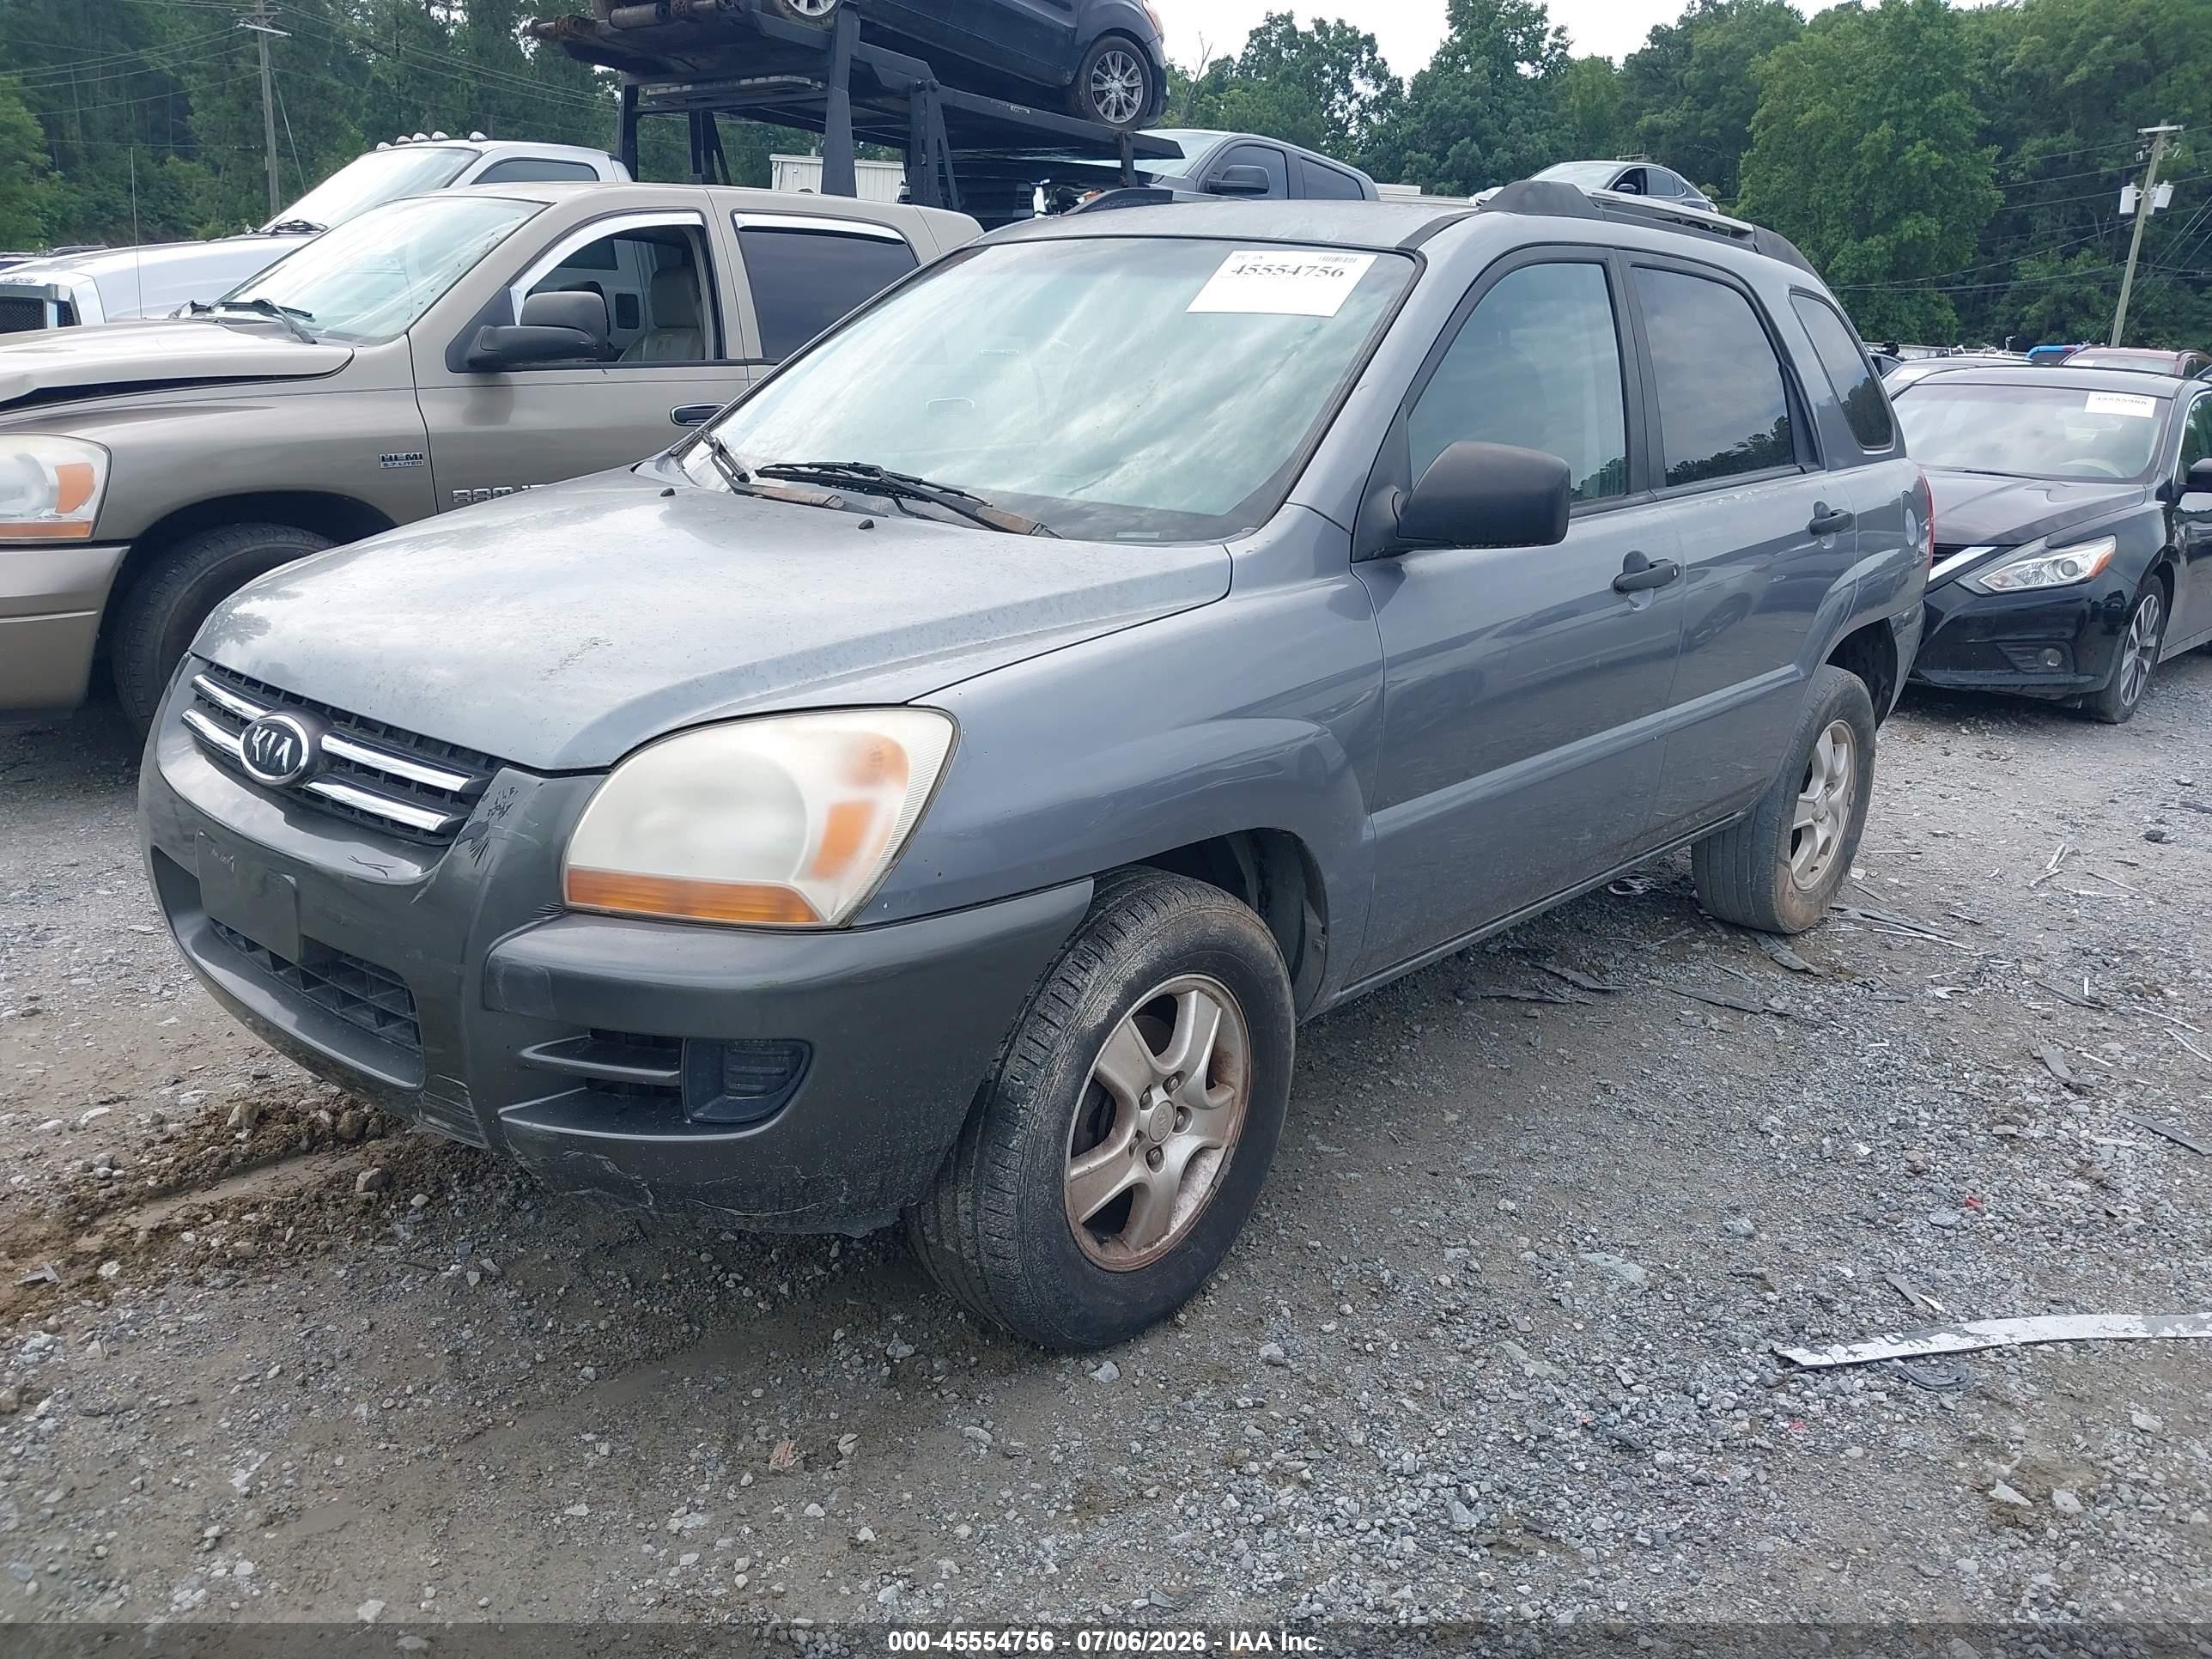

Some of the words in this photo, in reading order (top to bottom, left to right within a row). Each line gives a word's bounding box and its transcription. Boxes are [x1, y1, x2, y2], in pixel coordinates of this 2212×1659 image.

[1231, 264, 1346, 277] 45554756
[381, 453, 423, 462] HEMI
[246, 726, 293, 773] KIA
